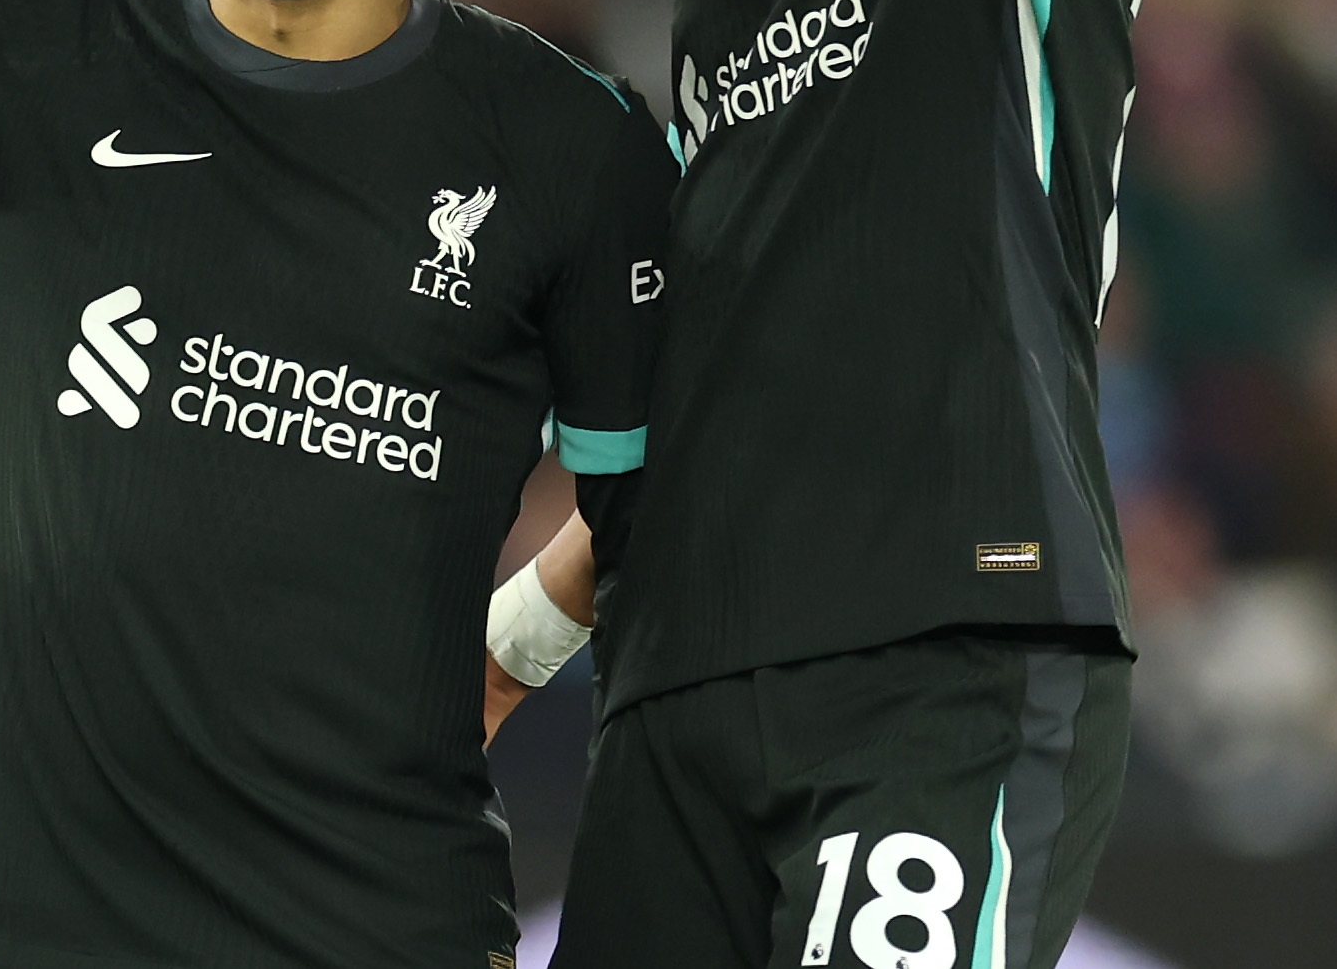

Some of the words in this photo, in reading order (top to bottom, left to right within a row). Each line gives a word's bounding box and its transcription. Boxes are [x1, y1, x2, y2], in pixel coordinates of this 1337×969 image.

[409, 267, 473, 309] L.F.C.
[178, 333, 442, 432] standard
[171, 384, 443, 482] chartered
[801, 831, 965, 969] 18
